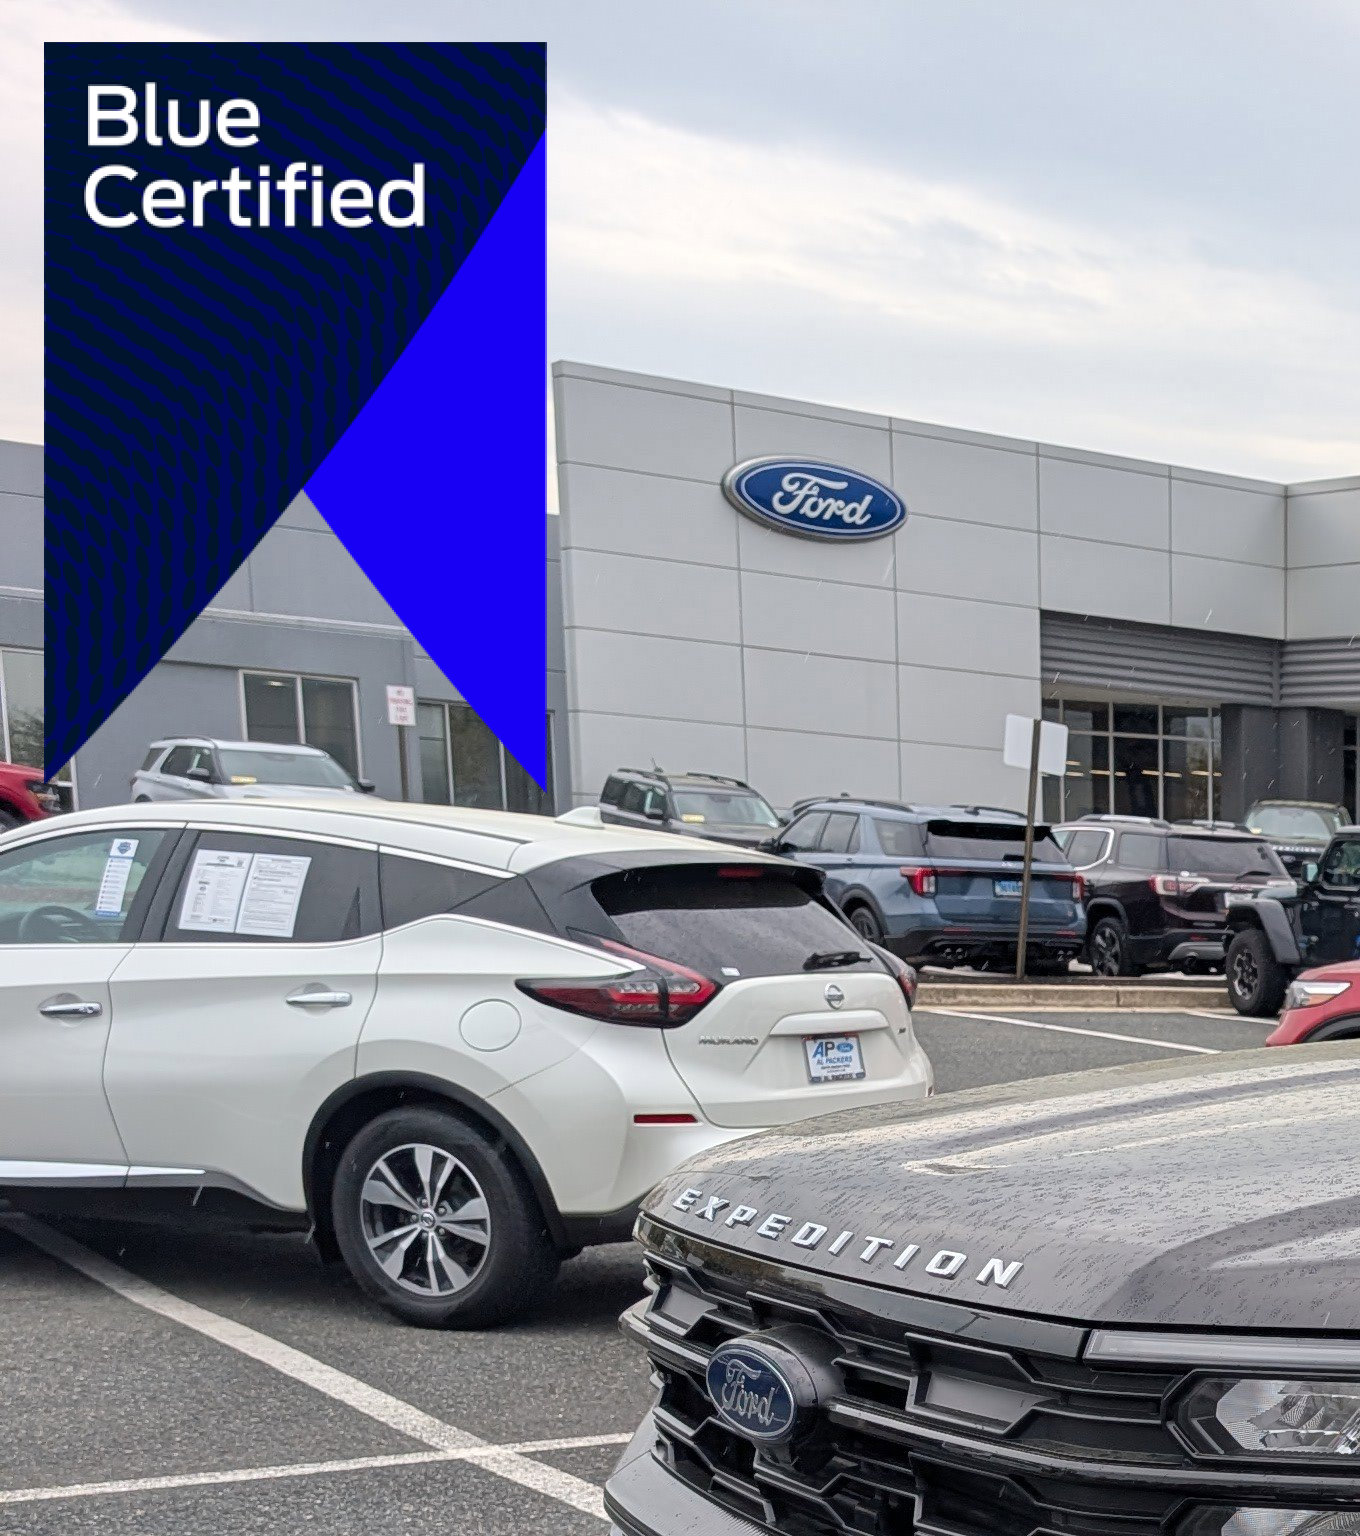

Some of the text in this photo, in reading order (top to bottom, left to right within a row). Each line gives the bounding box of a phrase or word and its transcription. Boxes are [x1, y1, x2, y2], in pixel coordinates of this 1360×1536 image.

[772, 472, 874, 525] Ford
[812, 1041, 835, 1058] AP
[673, 1188, 1024, 1289] EXPEDITION
[722, 1359, 776, 1426] Ford
